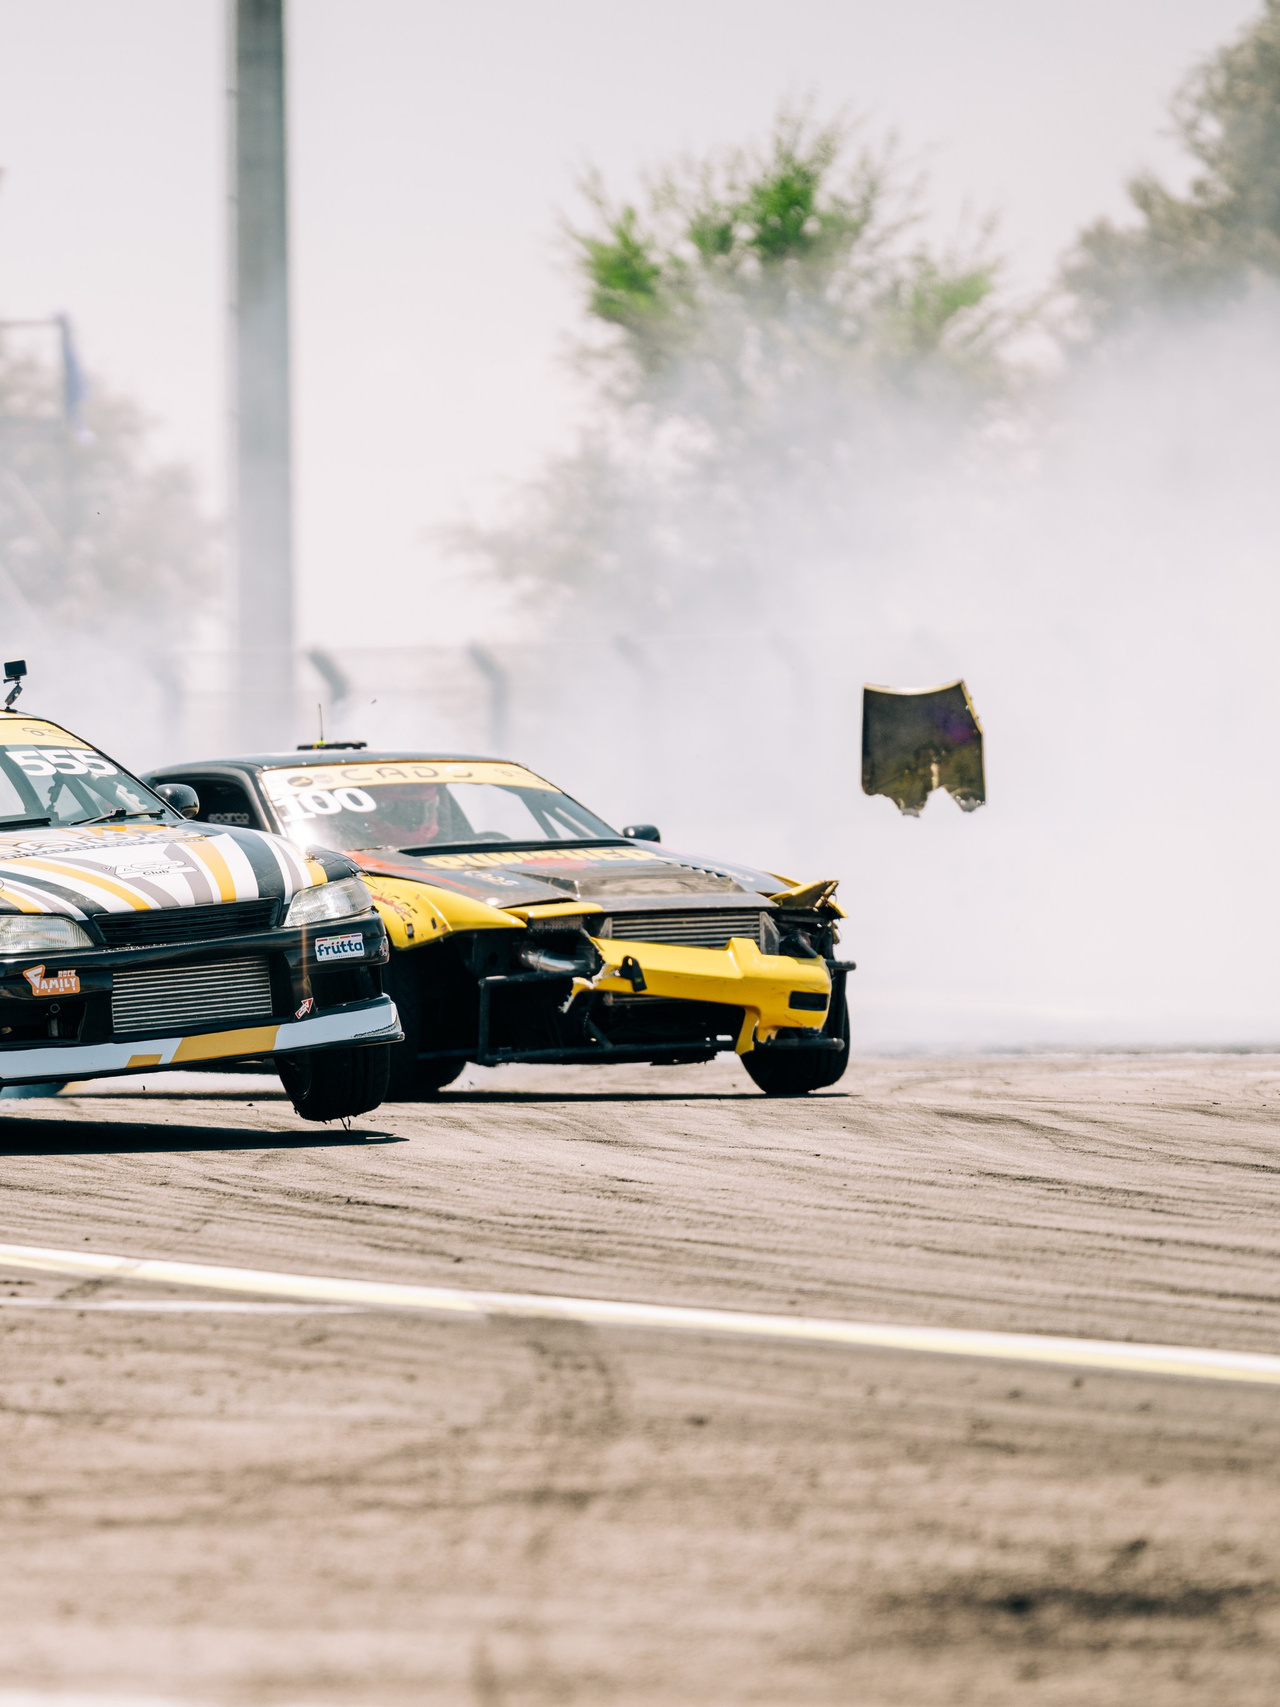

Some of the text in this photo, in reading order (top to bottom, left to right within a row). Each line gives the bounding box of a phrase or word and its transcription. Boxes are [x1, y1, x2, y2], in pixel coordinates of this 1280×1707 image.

[5, 749, 118, 776] 555
[340, 765, 473, 782] CADS
[274, 787, 377, 822] 100
[208, 813, 249, 825] sparco
[317, 940, 363, 956] frütta
[25, 967, 76, 989] FAMILY
